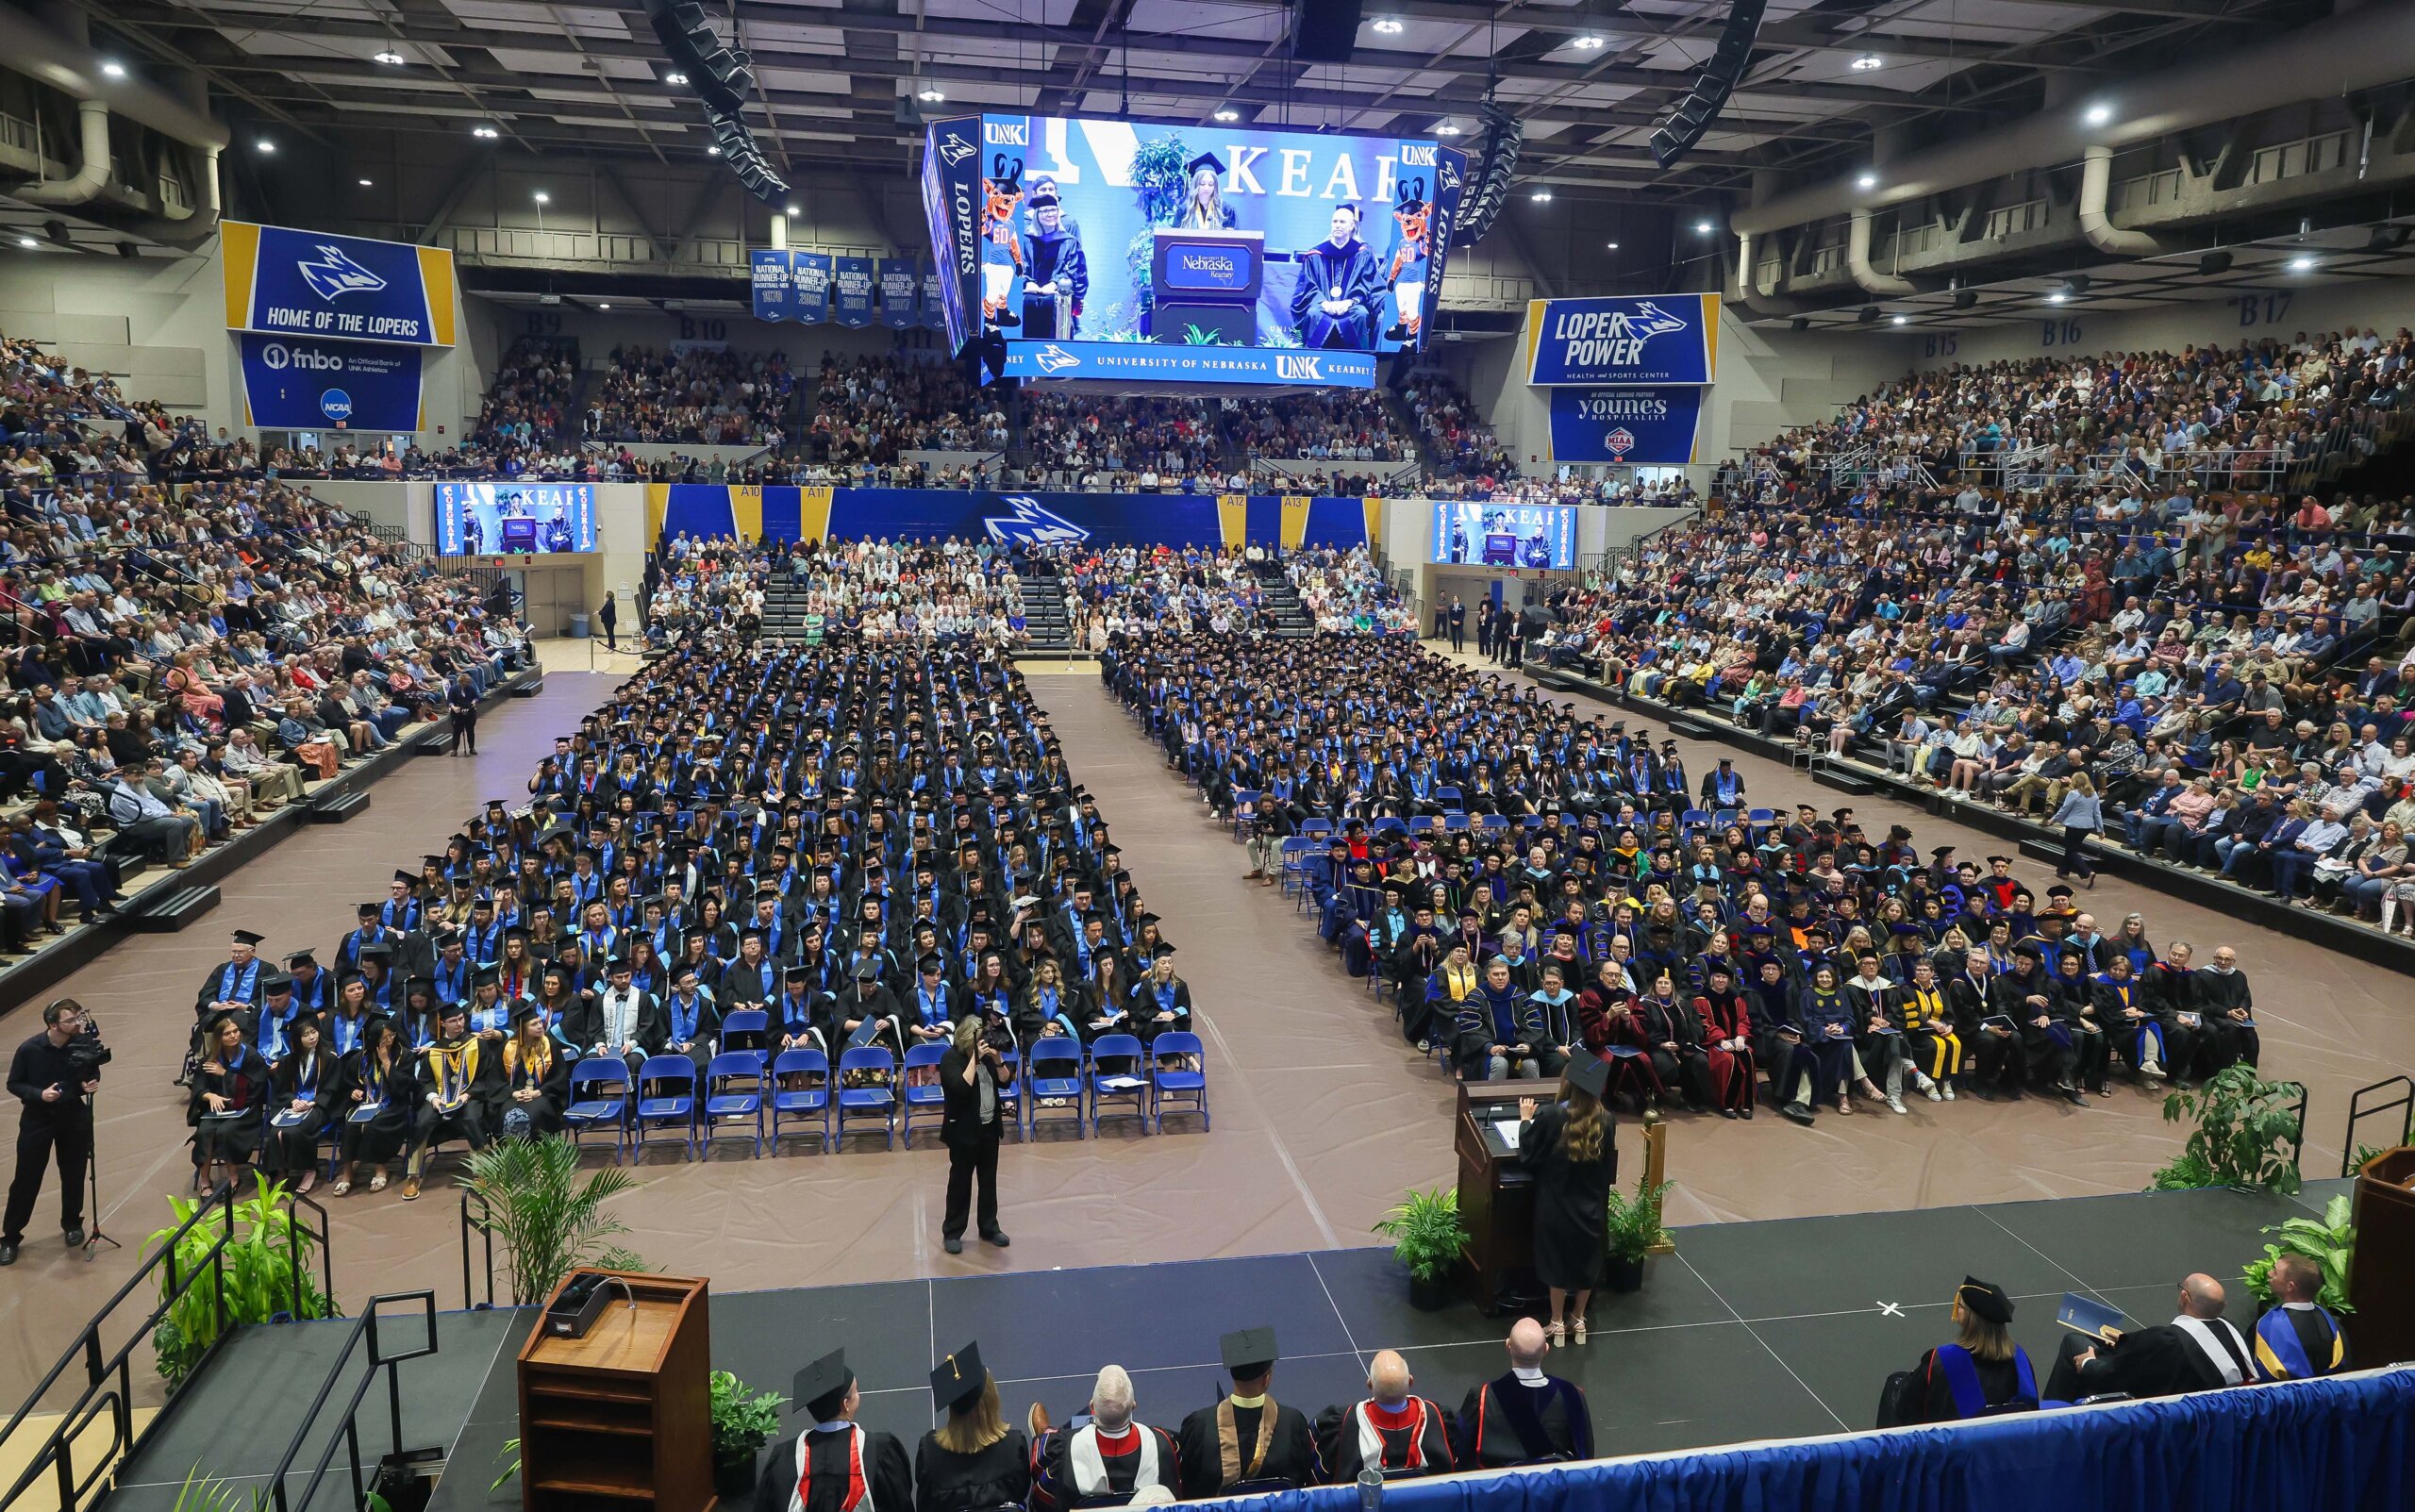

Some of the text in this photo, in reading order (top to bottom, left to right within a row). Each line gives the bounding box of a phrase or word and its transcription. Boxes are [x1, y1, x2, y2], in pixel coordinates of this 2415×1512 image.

[984, 124, 1025, 145] UNK
[1401, 144, 1437, 166] UNK
[955, 181, 975, 274] LOPERS
[1428, 207, 1450, 294] LOPERS
[756, 264, 786, 274] NATIONAL
[1182, 255, 1233, 271] Nebraska
[754, 274, 789, 282] RUNNER-UP
[797, 267, 826, 278] NATIONAL
[840, 272, 869, 281] NATIONAL
[883, 274, 912, 282] NATIONAL
[794, 274, 829, 287] RUNNER-UP
[837, 279, 872, 290] RUNNER-UP
[881, 282, 915, 291] RUNNER-UP
[797, 283, 825, 293] WRESTLING
[841, 288, 869, 296] WRESTLING
[267, 307, 419, 337] HOME OF THE LOPERS
[1555, 312, 1625, 340] LOPER
[291, 348, 342, 370] fnbo
[1564, 340, 1644, 366] POWER
[1097, 355, 1370, 380] UNIVERSITY OF NEBRASKA UNK KEARNEY
[325, 403, 351, 412] NCAA
[1578, 399, 1667, 420] younes
